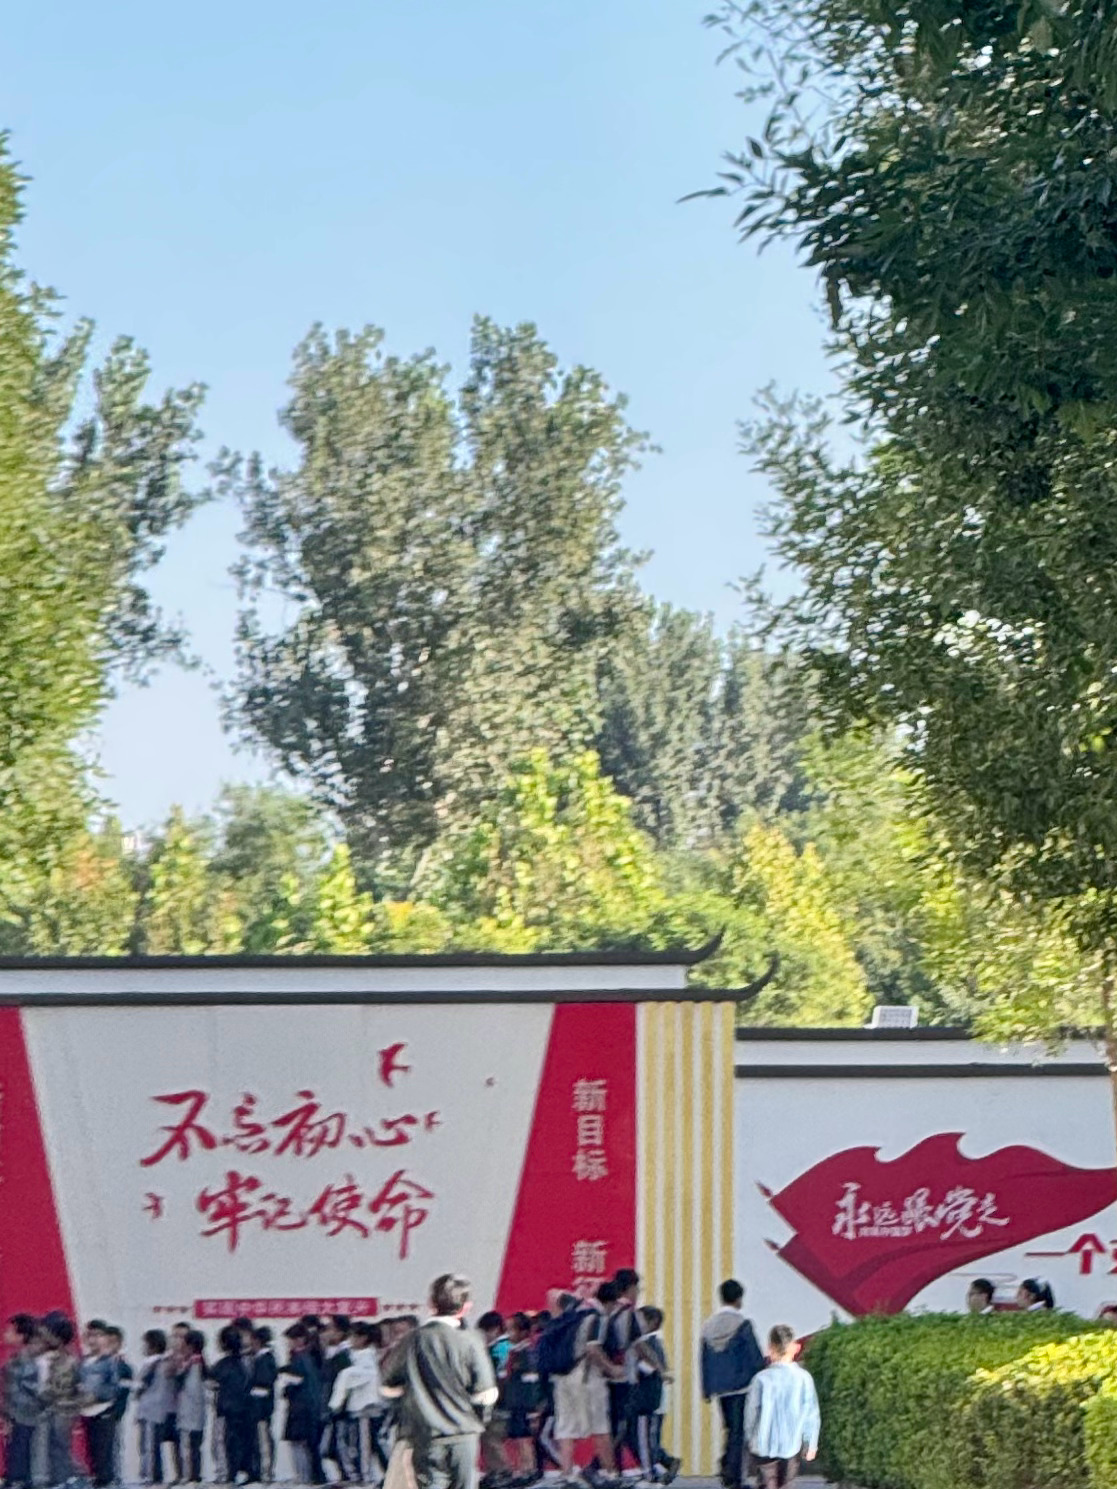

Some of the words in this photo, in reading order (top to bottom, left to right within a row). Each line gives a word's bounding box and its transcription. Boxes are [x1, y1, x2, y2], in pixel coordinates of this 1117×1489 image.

[139, 1089, 419, 1167] 不忘初心
[571, 1078, 608, 1181] 新目标
[195, 1169, 435, 1260] 牢记使命
[831, 1181, 1011, 1241] 永远跟党走
